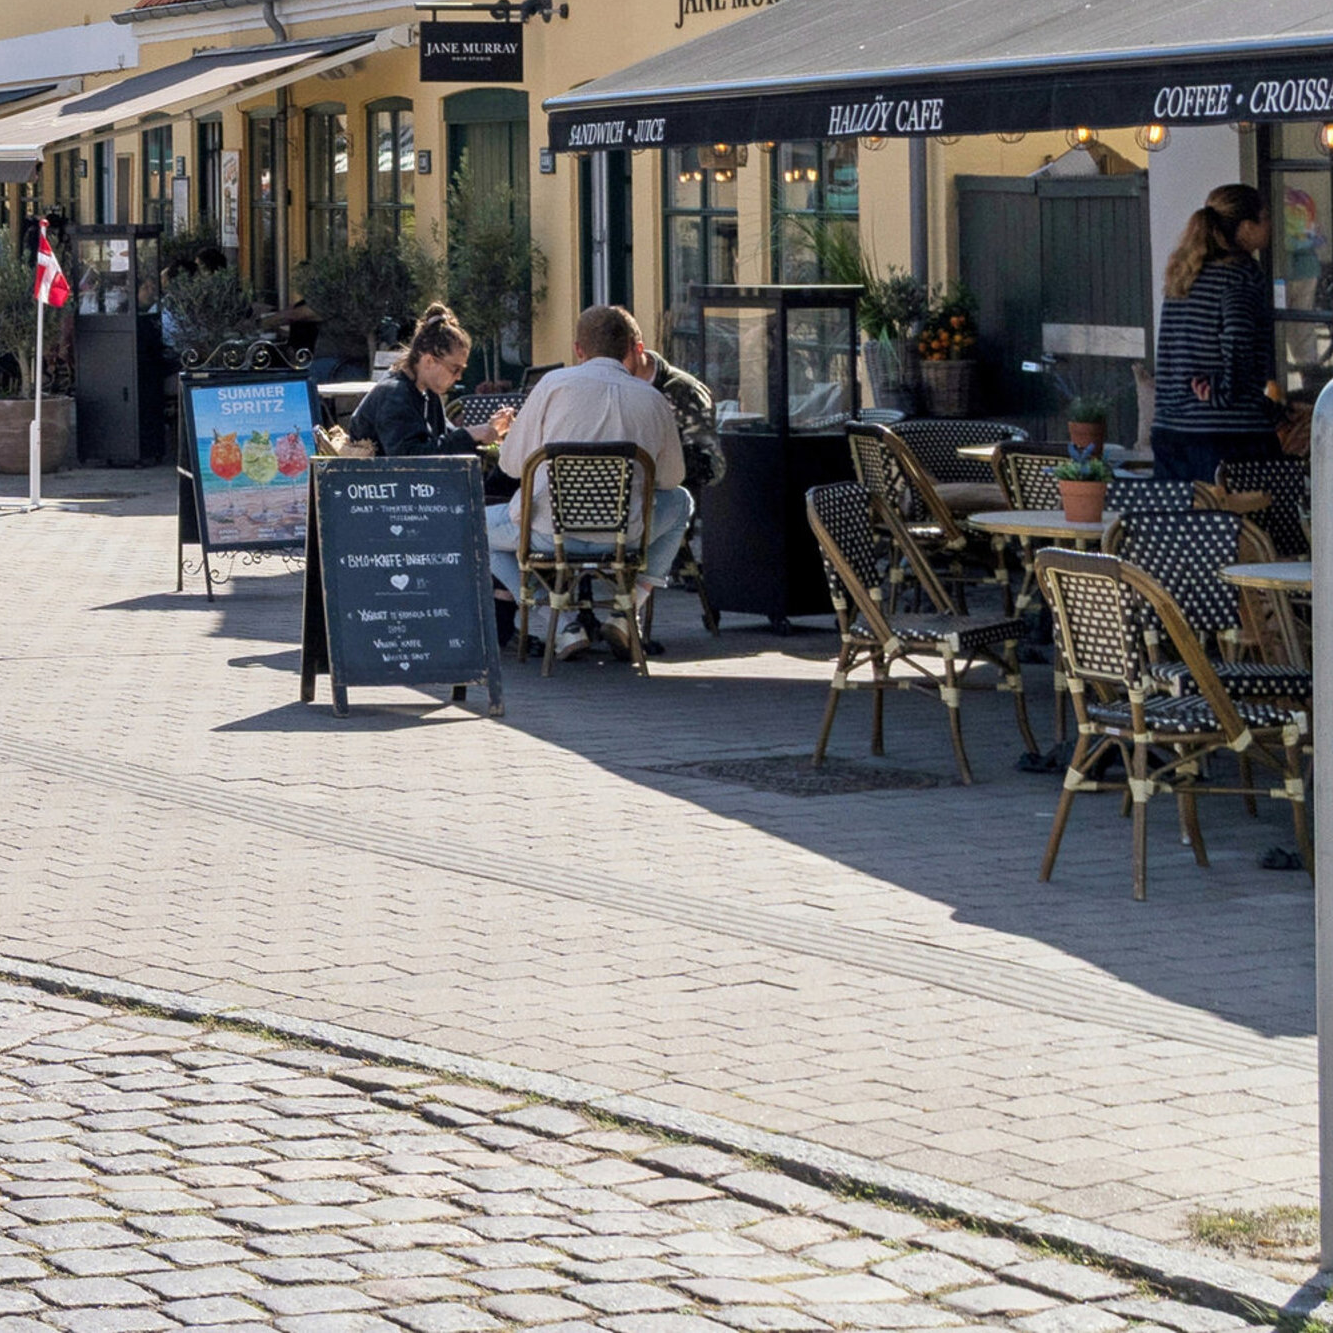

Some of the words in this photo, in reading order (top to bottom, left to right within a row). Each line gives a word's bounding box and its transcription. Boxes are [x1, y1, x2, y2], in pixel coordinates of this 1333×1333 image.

[424, 42, 459, 57] JANE
[462, 42, 518, 54] MURRAY
[1154, 84, 1232, 118] COFFEE
[827, 94, 894, 136] HALLÖY
[895, 98, 944, 132] CAFE
[568, 120, 625, 146] SANDWICH
[634, 118, 666, 143] JUICE
[217, 385, 285, 401] SUMMER
[221, 399, 285, 416] SPRITZ
[347, 482, 399, 499] OMELET
